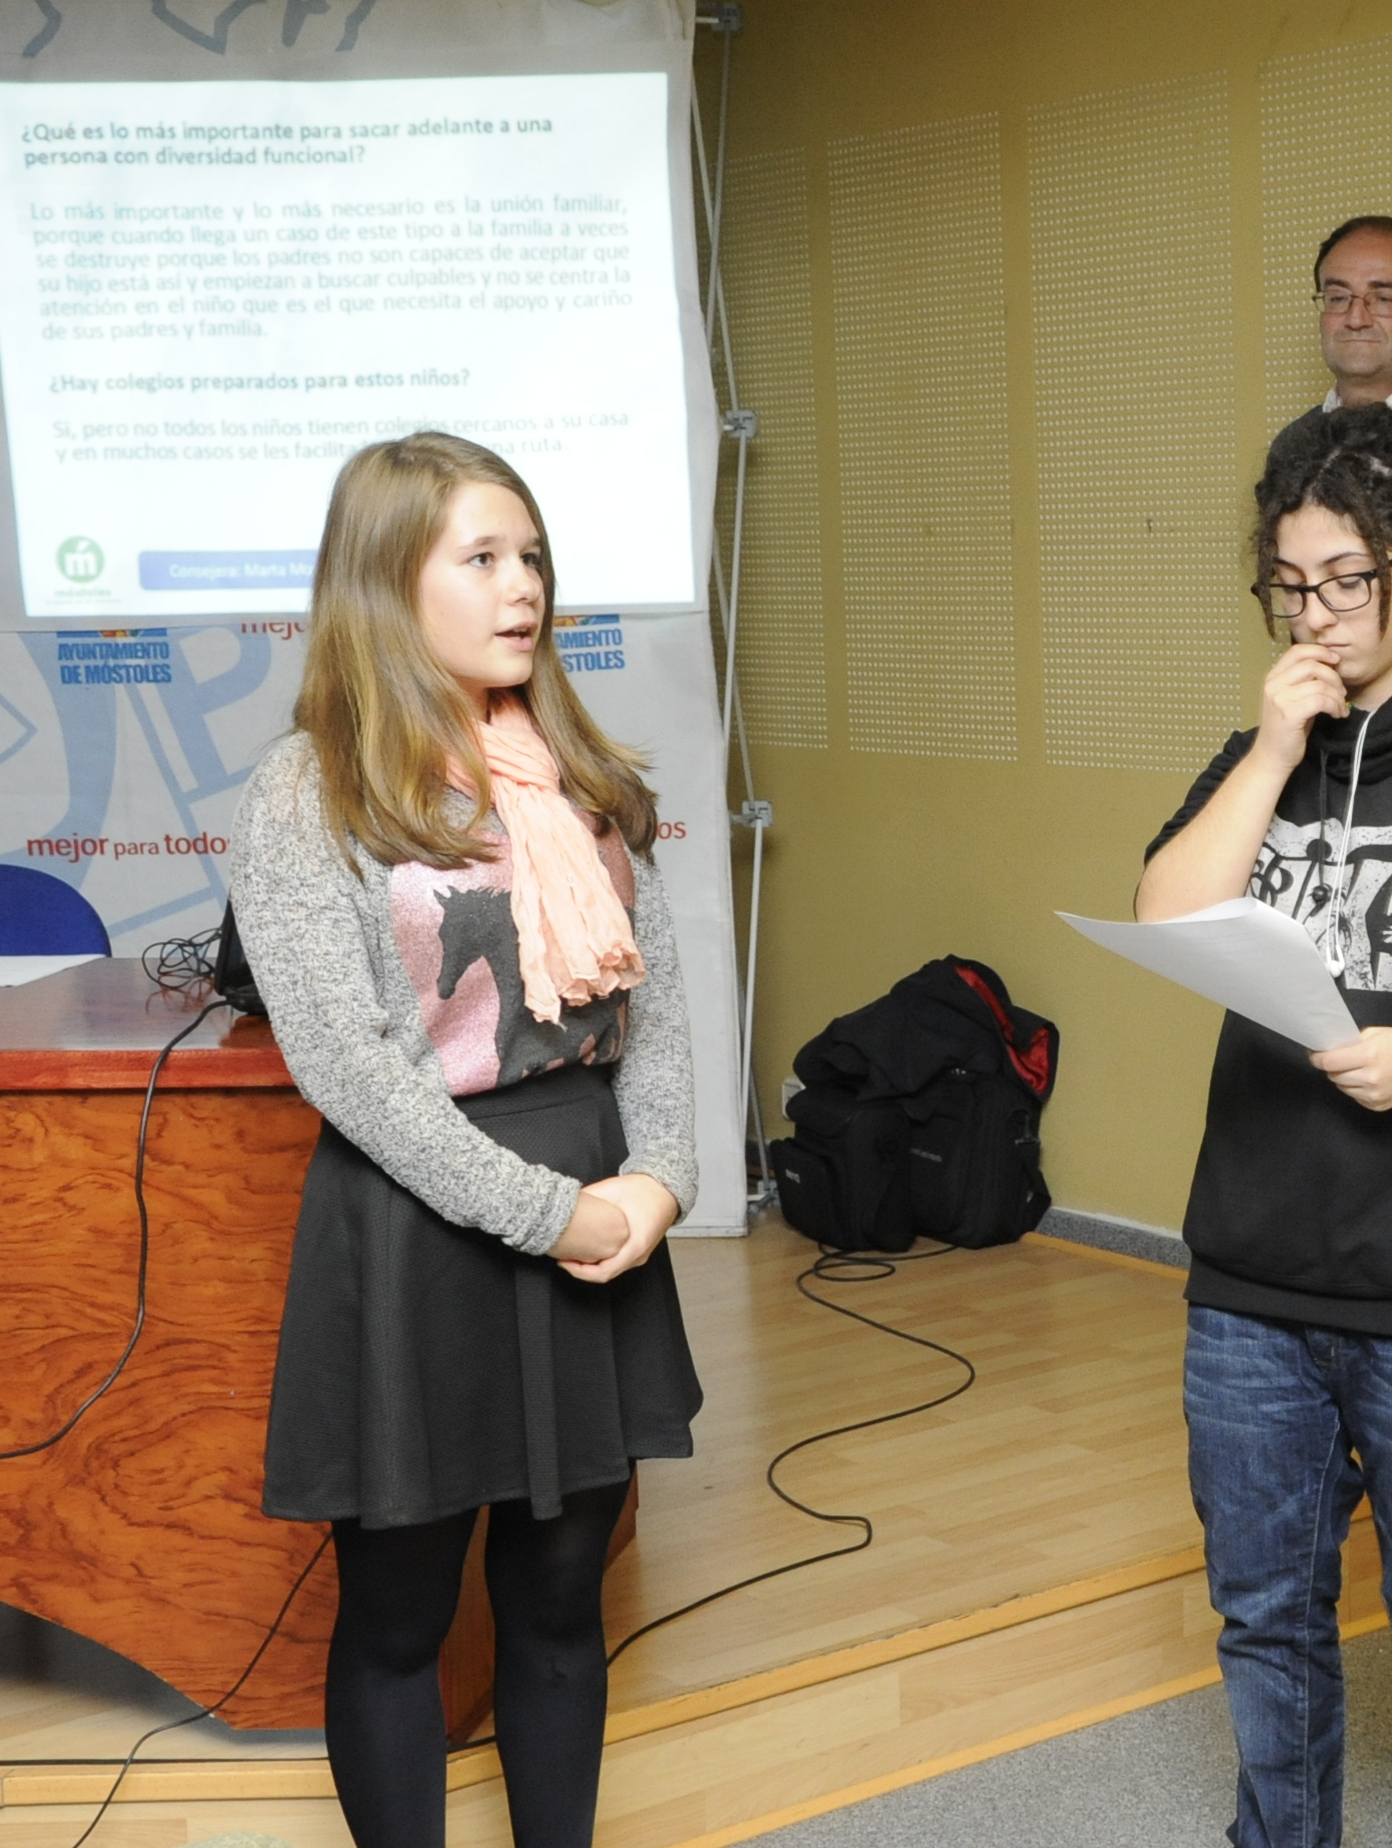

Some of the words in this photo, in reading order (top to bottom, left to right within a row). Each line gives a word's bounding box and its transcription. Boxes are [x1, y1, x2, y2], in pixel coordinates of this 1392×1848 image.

[21, 119, 76, 143] ¿Qué
[82, 125, 104, 140] es
[110, 121, 129, 139] lo
[136, 121, 176, 140] más
[182, 121, 293, 143] importante
[301, 125, 342, 143] para
[350, 123, 399, 138] sacar
[407, 118, 494, 136] adelante
[500, 120, 510, 133] a
[516, 118, 553, 133] una
[24, 151, 108, 169] persona
[114, 151, 149, 164] con
[155, 146, 257, 164] diversidad
[264, 145, 365, 164] funcional?
[30, 202, 54, 220] Lo
[64, 201, 105, 219] más
[114, 201, 224, 222] importante
[233, 206, 244, 221] y
[253, 201, 272, 218] lo
[282, 198, 322, 217] más
[331, 199, 425, 217] necesario
[434, 201, 456, 214] es
[465, 195, 482, 213] la
[490, 194, 544, 212] unión
[553, 193, 627, 215] familiar,
[33, 230, 104, 246] porque
[111, 227, 184, 244] cuando
[191, 226, 236, 246] llega
[244, 228, 269, 241] un
[276, 226, 319, 241] caso
[326, 223, 350, 241] de
[358, 224, 397, 240] este
[405, 221, 444, 241] tipo
[451, 224, 462, 237] a
[468, 219, 484, 237] la
[491, 218, 553, 237] familia
[560, 223, 571, 237] a
[577, 221, 629, 237] veces
[36, 253, 58, 267] se
[64, 250, 150, 270] destruye
[157, 252, 227, 270] porque
[233, 249, 261, 266] los
[268, 249, 331, 268] padres
[338, 248, 363, 264] no
[369, 248, 403, 263] son
[409, 245, 484, 265] capaces
[490, 244, 513, 261] de
[519, 245, 587, 265] aceptar
[593, 244, 631, 264] que
[38, 278, 60, 293] su
[66, 275, 102, 296] hijo
[187, 276, 198, 293] y
[203, 273, 296, 293] empiezan
[302, 276, 312, 289] a
[318, 270, 380, 289] buscar
[387, 268, 476, 288] culpables
[481, 271, 493, 288] y
[497, 271, 520, 285] no
[526, 270, 545, 285] se
[549, 268, 609, 286] centra
[614, 266, 632, 284] la
[40, 297, 127, 316] atención
[134, 300, 159, 314] en
[168, 296, 185, 314] el
[193, 295, 236, 313] niño
[243, 299, 278, 315] que
[287, 299, 307, 313] es
[314, 295, 331, 312] el
[339, 297, 375, 315] que
[383, 293, 462, 311] necesita
[469, 291, 486, 309] el
[493, 293, 549, 312] apoyo
[556, 294, 566, 311] y
[573, 289, 633, 308] cariño
[42, 322, 67, 340] de
[73, 324, 104, 338] sus
[110, 320, 179, 341] padres
[183, 322, 195, 340] y
[200, 319, 268, 338] familia.
[49, 375, 98, 394] ¿Hay
[105, 372, 185, 393] colegios
[190, 371, 299, 393] preparados
[304, 373, 347, 392] para
[355, 371, 404, 387] estos
[410, 368, 470, 387] niños?
[82, 423, 129, 440] pero
[134, 423, 158, 437] no
[164, 420, 216, 437] todos
[221, 418, 248, 436] los
[252, 418, 302, 436] niños
[308, 417, 369, 435] tienen
[453, 417, 536, 433] cercanos
[544, 417, 555, 429] a
[561, 414, 582, 428] su
[589, 412, 630, 427] casa
[55, 448, 67, 464] y
[72, 447, 96, 460] en
[103, 444, 177, 460] muchos
[183, 445, 234, 460] casos
[239, 445, 258, 459] se
[264, 443, 289, 459] les
[244, 563, 286, 577] Marta
[58, 641, 170, 660] AYUNTAMIENTO
[562, 650, 625, 672] STOLES
[60, 665, 81, 685] DE
[85, 662, 172, 685] MÓSTOLES
[27, 832, 109, 863] mejor
[114, 842, 160, 860] para
[164, 832, 230, 855] todo
